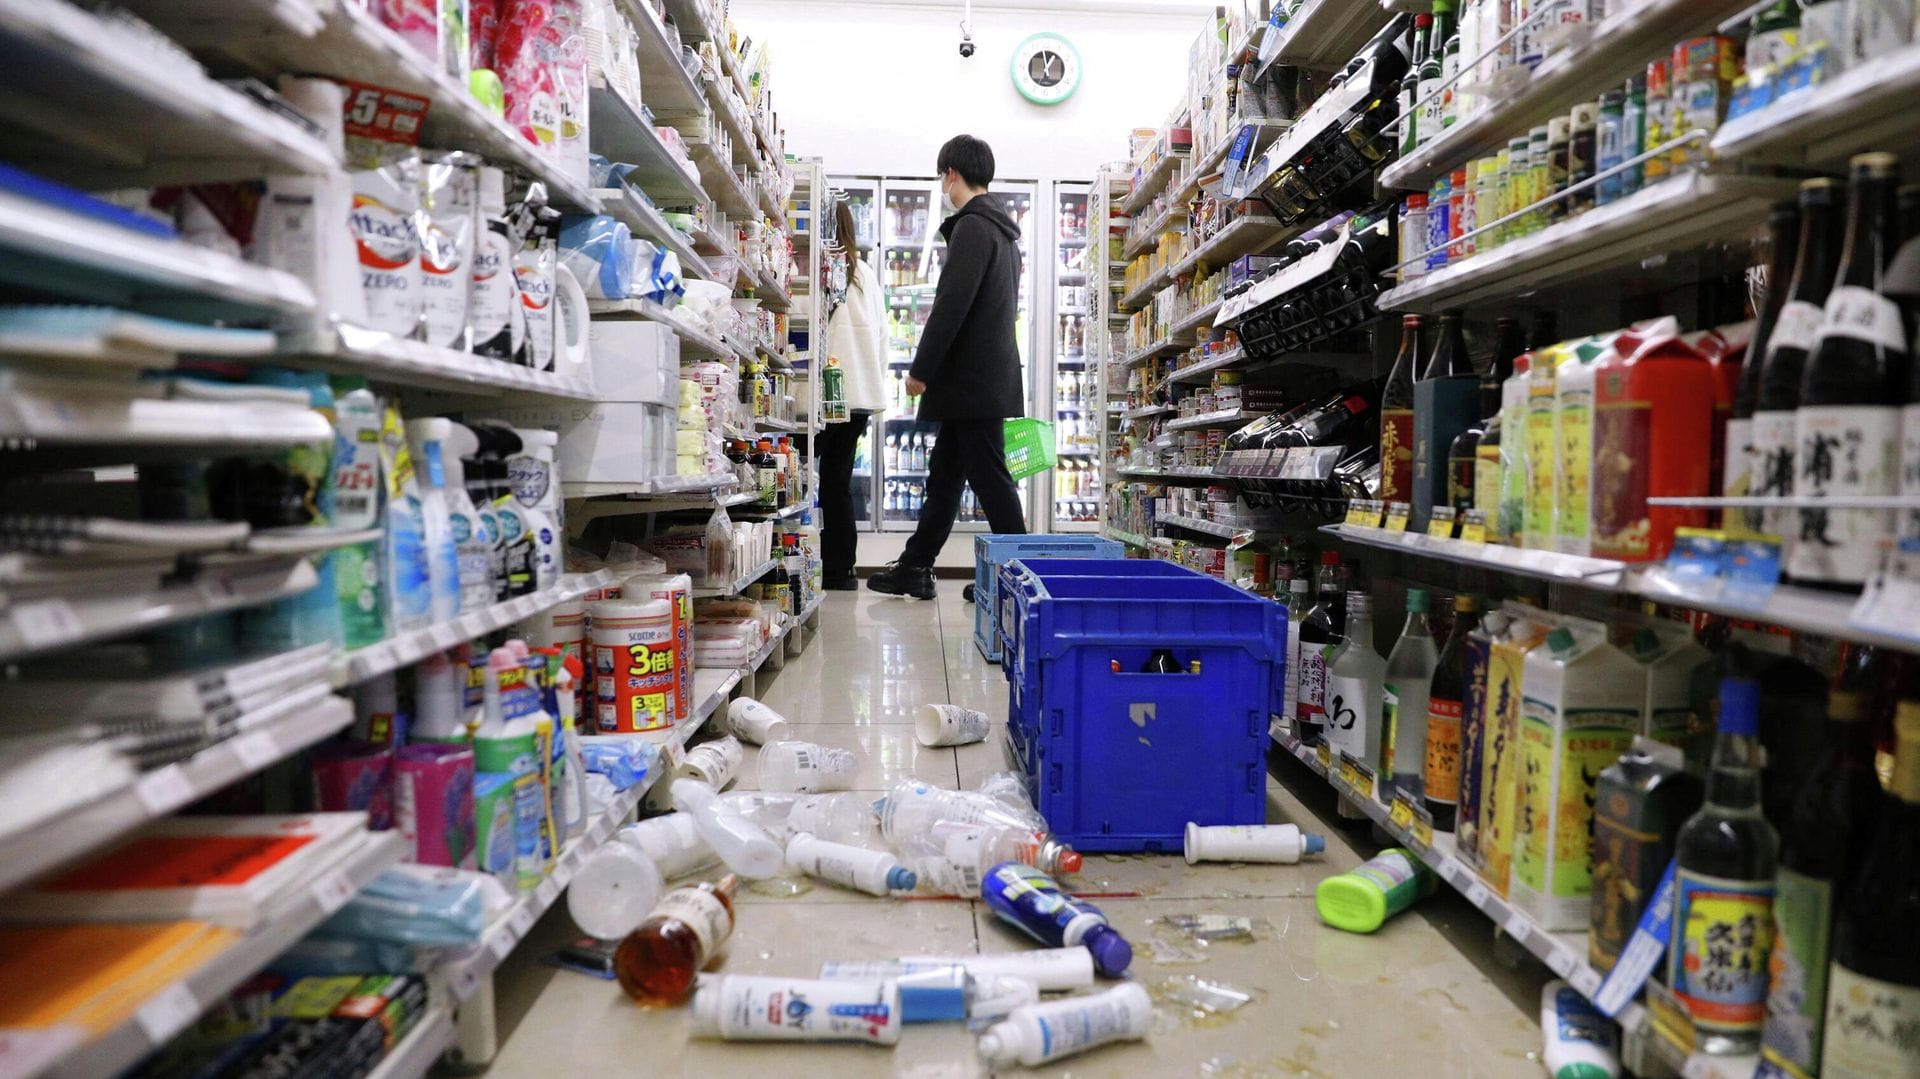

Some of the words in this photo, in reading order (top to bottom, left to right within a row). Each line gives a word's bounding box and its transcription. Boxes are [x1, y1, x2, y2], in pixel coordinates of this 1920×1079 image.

[362, 273, 408, 289] ZERO
[421, 275, 452, 289] ZERO
[629, 631, 656, 641] scottie
[635, 696, 646, 709] 3
